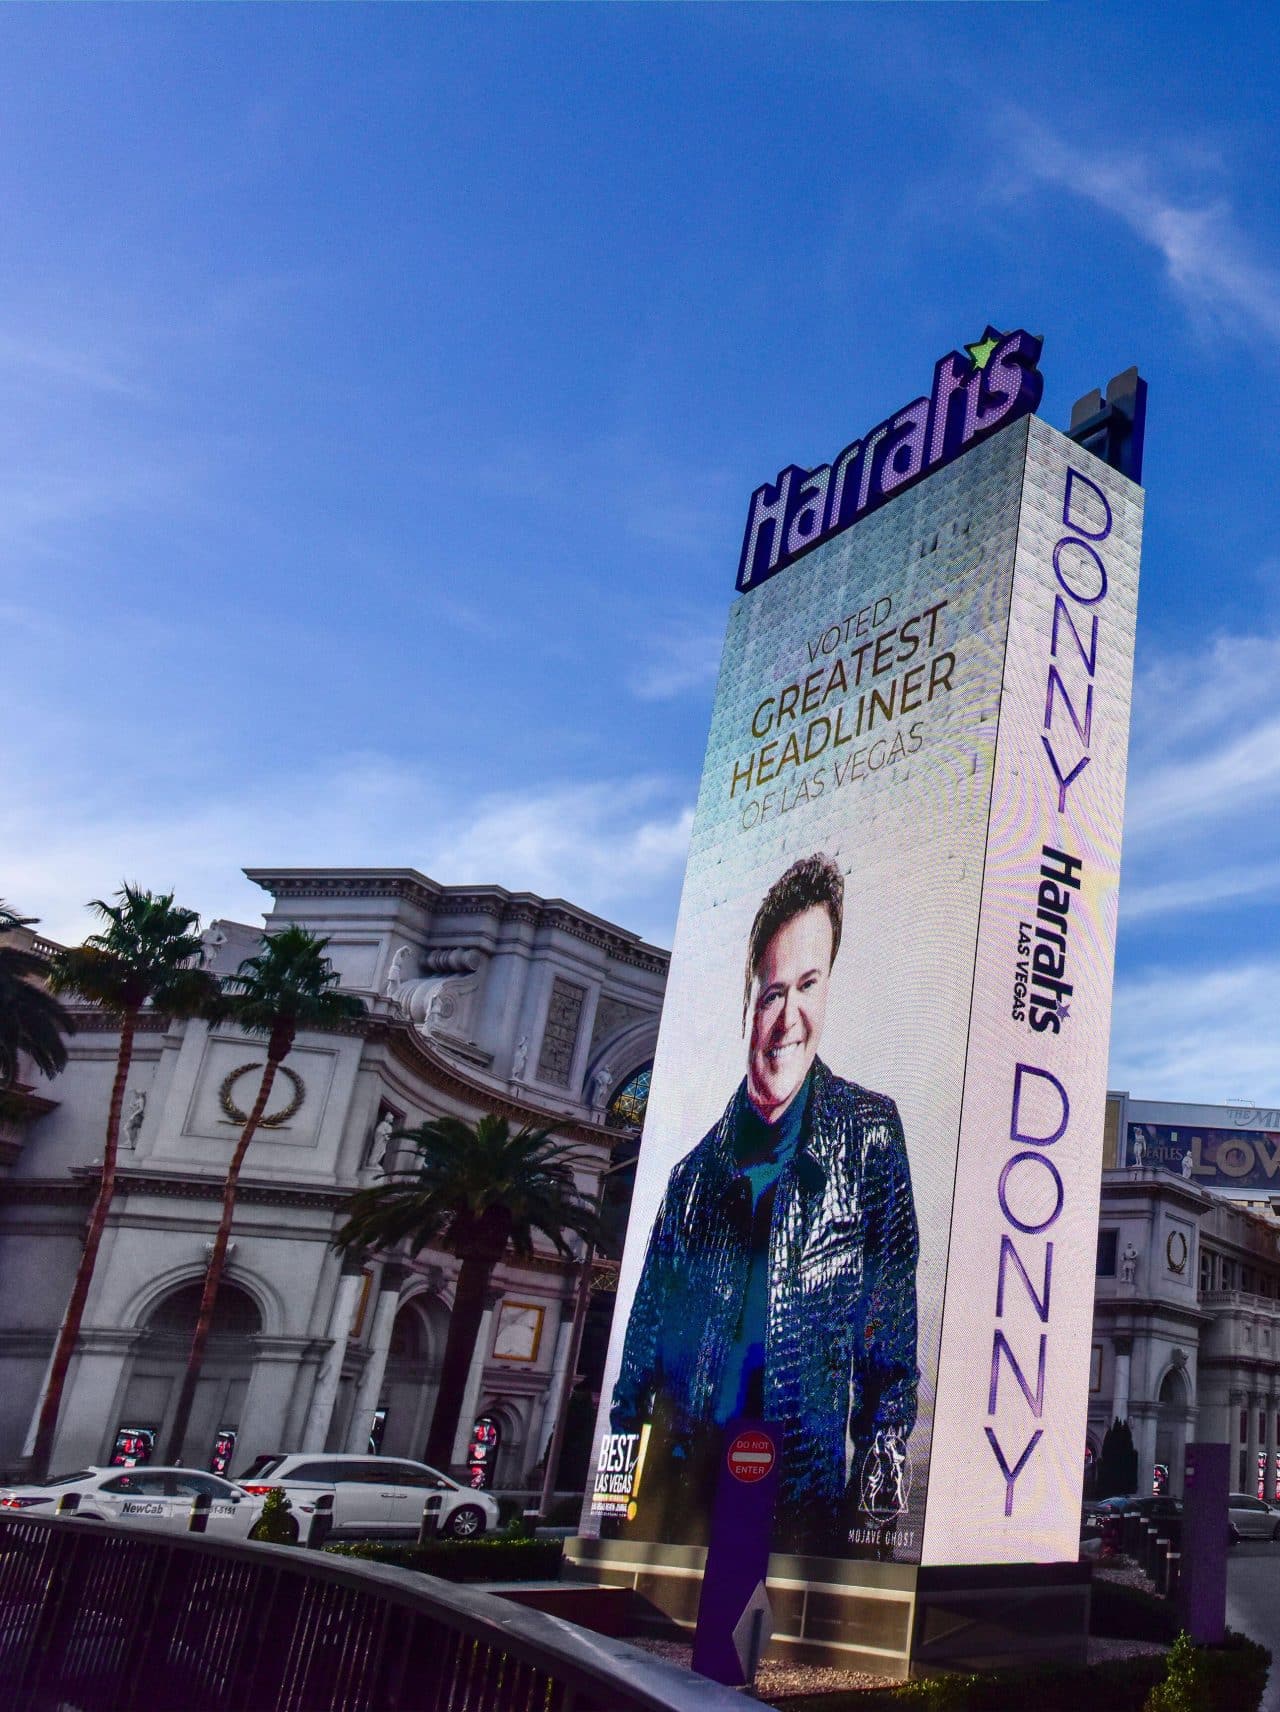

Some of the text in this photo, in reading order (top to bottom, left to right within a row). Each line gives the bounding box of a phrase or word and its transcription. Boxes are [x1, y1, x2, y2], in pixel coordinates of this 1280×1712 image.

[808, 597, 892, 663] VOTED
[1041, 466, 1113, 814] DONNY
[752, 600, 948, 738] GREATEST
[730, 652, 956, 799] HEADLINER
[742, 722, 924, 829] OF LAS VEGAS
[1012, 921, 1032, 1022] LAS VEGAS
[1226, 1109, 1250, 1120] THE
[984, 1062, 1070, 1517] DONNY
[597, 1433, 637, 1472] BEST
[735, 1465, 765, 1474] ENTER
[736, 1440, 769, 1449] DO NOT
[122, 1502, 163, 1514] NewCab
[594, 1473, 633, 1494] LAS VEGAS
[848, 1529, 915, 1546] MOJAVE GHOST
